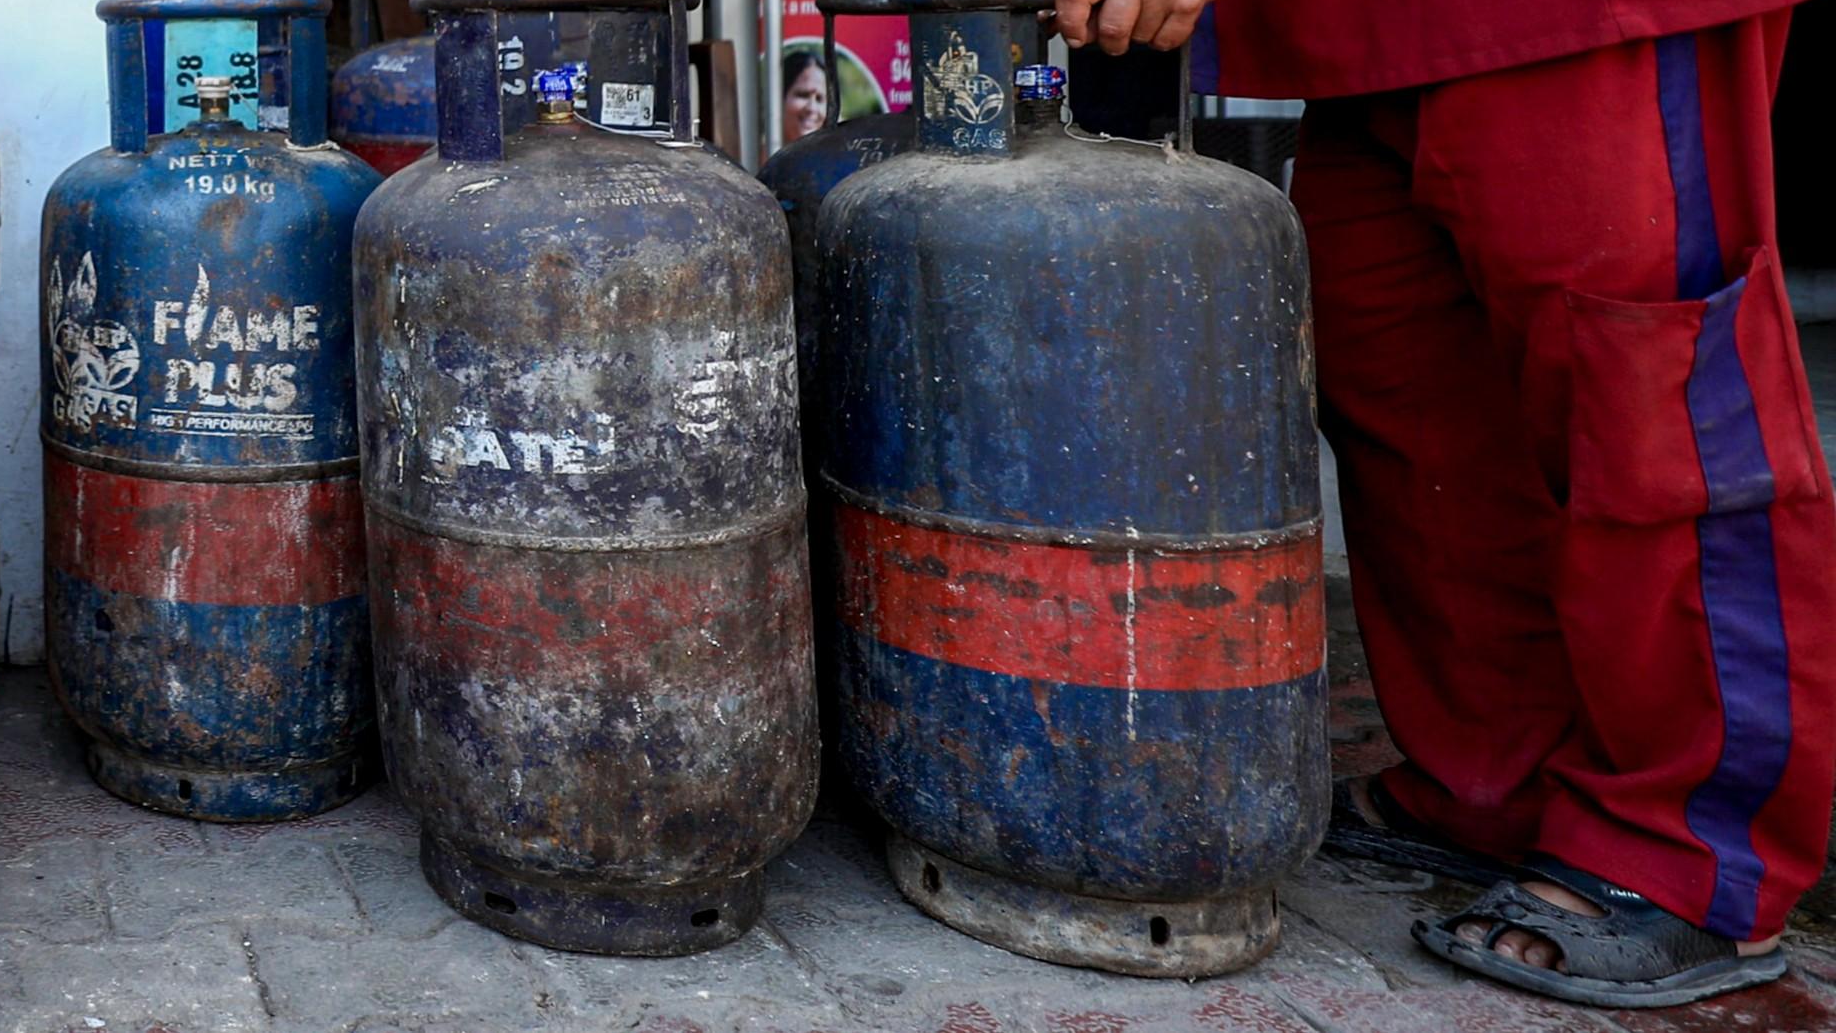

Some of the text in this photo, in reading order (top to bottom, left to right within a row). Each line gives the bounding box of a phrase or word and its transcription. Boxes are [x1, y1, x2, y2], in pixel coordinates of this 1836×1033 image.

[626, 89, 641, 102] 61
[952, 127, 1006, 149] GAS
[169, 154, 237, 170] NETT
[184, 174, 276, 203] 19.0 kg
[165, 358, 297, 411] PLUS
